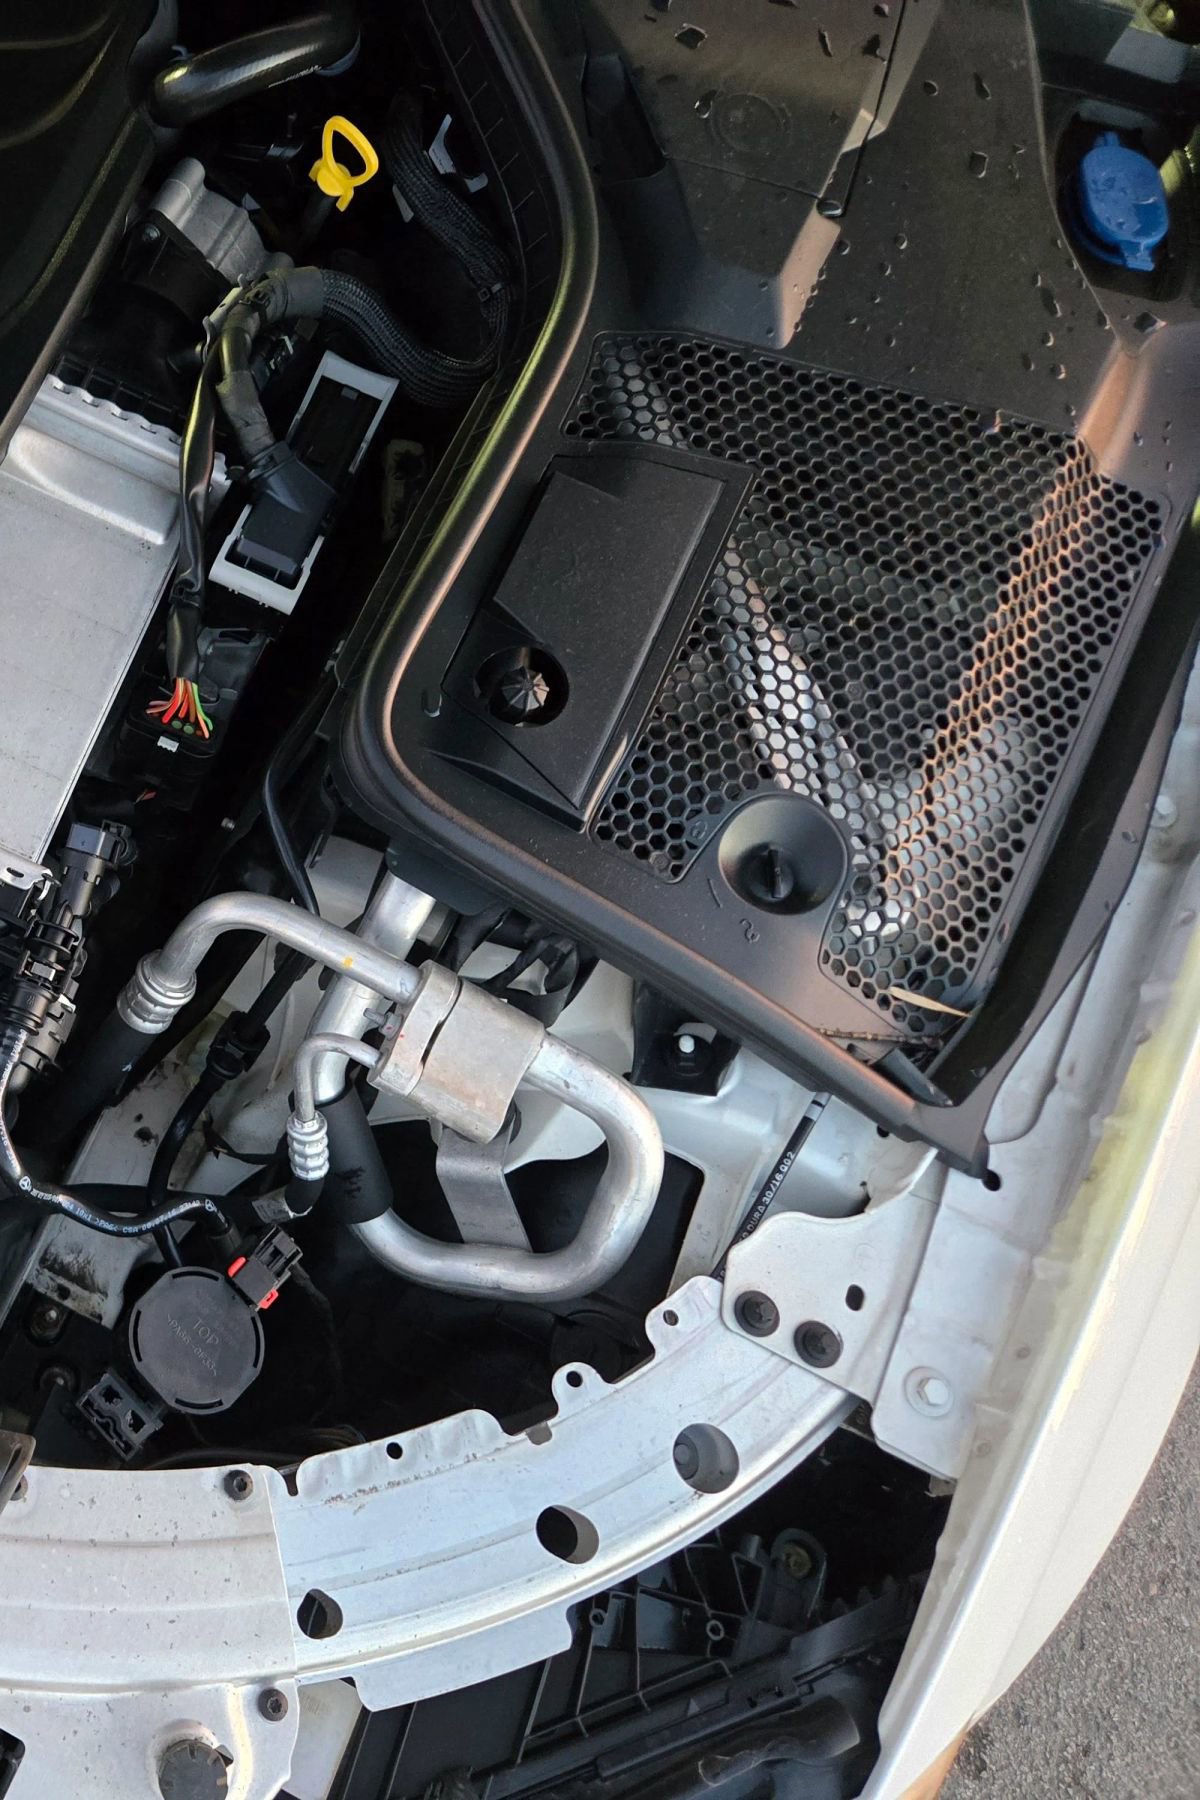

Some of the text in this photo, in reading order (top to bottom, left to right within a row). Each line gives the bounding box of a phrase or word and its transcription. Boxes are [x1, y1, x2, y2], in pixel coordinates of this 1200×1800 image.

[746, 1204, 766, 1232] DURA
[761, 1173, 784, 1207] 30/16
[193, 1318, 219, 1345] TOP
